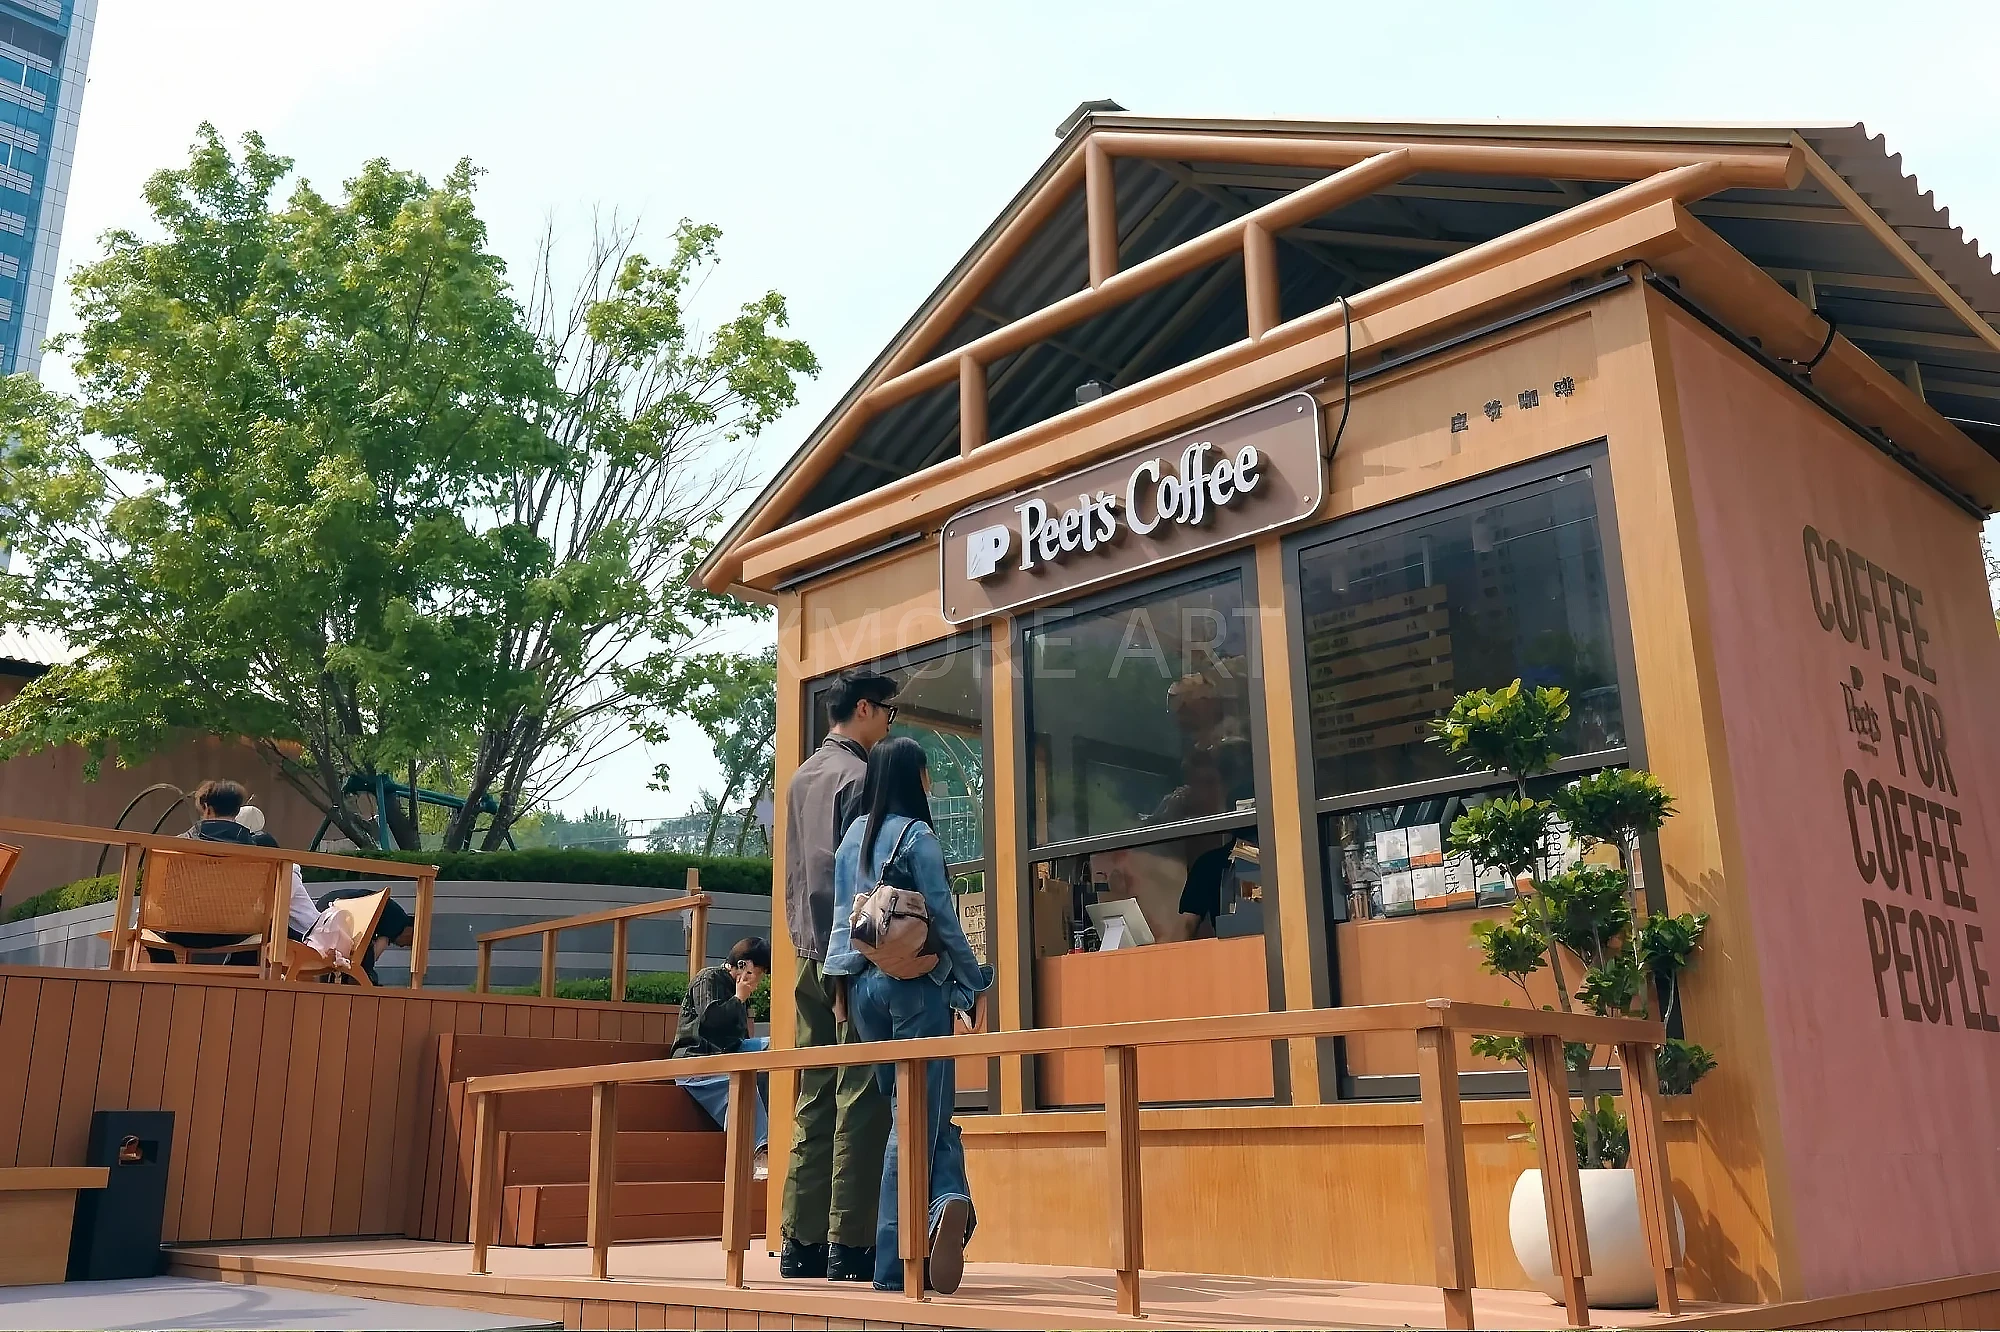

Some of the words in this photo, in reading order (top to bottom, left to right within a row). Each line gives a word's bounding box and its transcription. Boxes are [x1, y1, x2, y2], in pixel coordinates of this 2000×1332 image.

[1014, 490, 1116, 571] Peet's
[1126, 441, 1260, 535] Coffee
[1803, 525, 1937, 685] COFFEE
[1883, 673, 1958, 797] FOR
[1843, 769, 1978, 914] COFFEE
[1862, 898, 1999, 1032] PEOPLE
